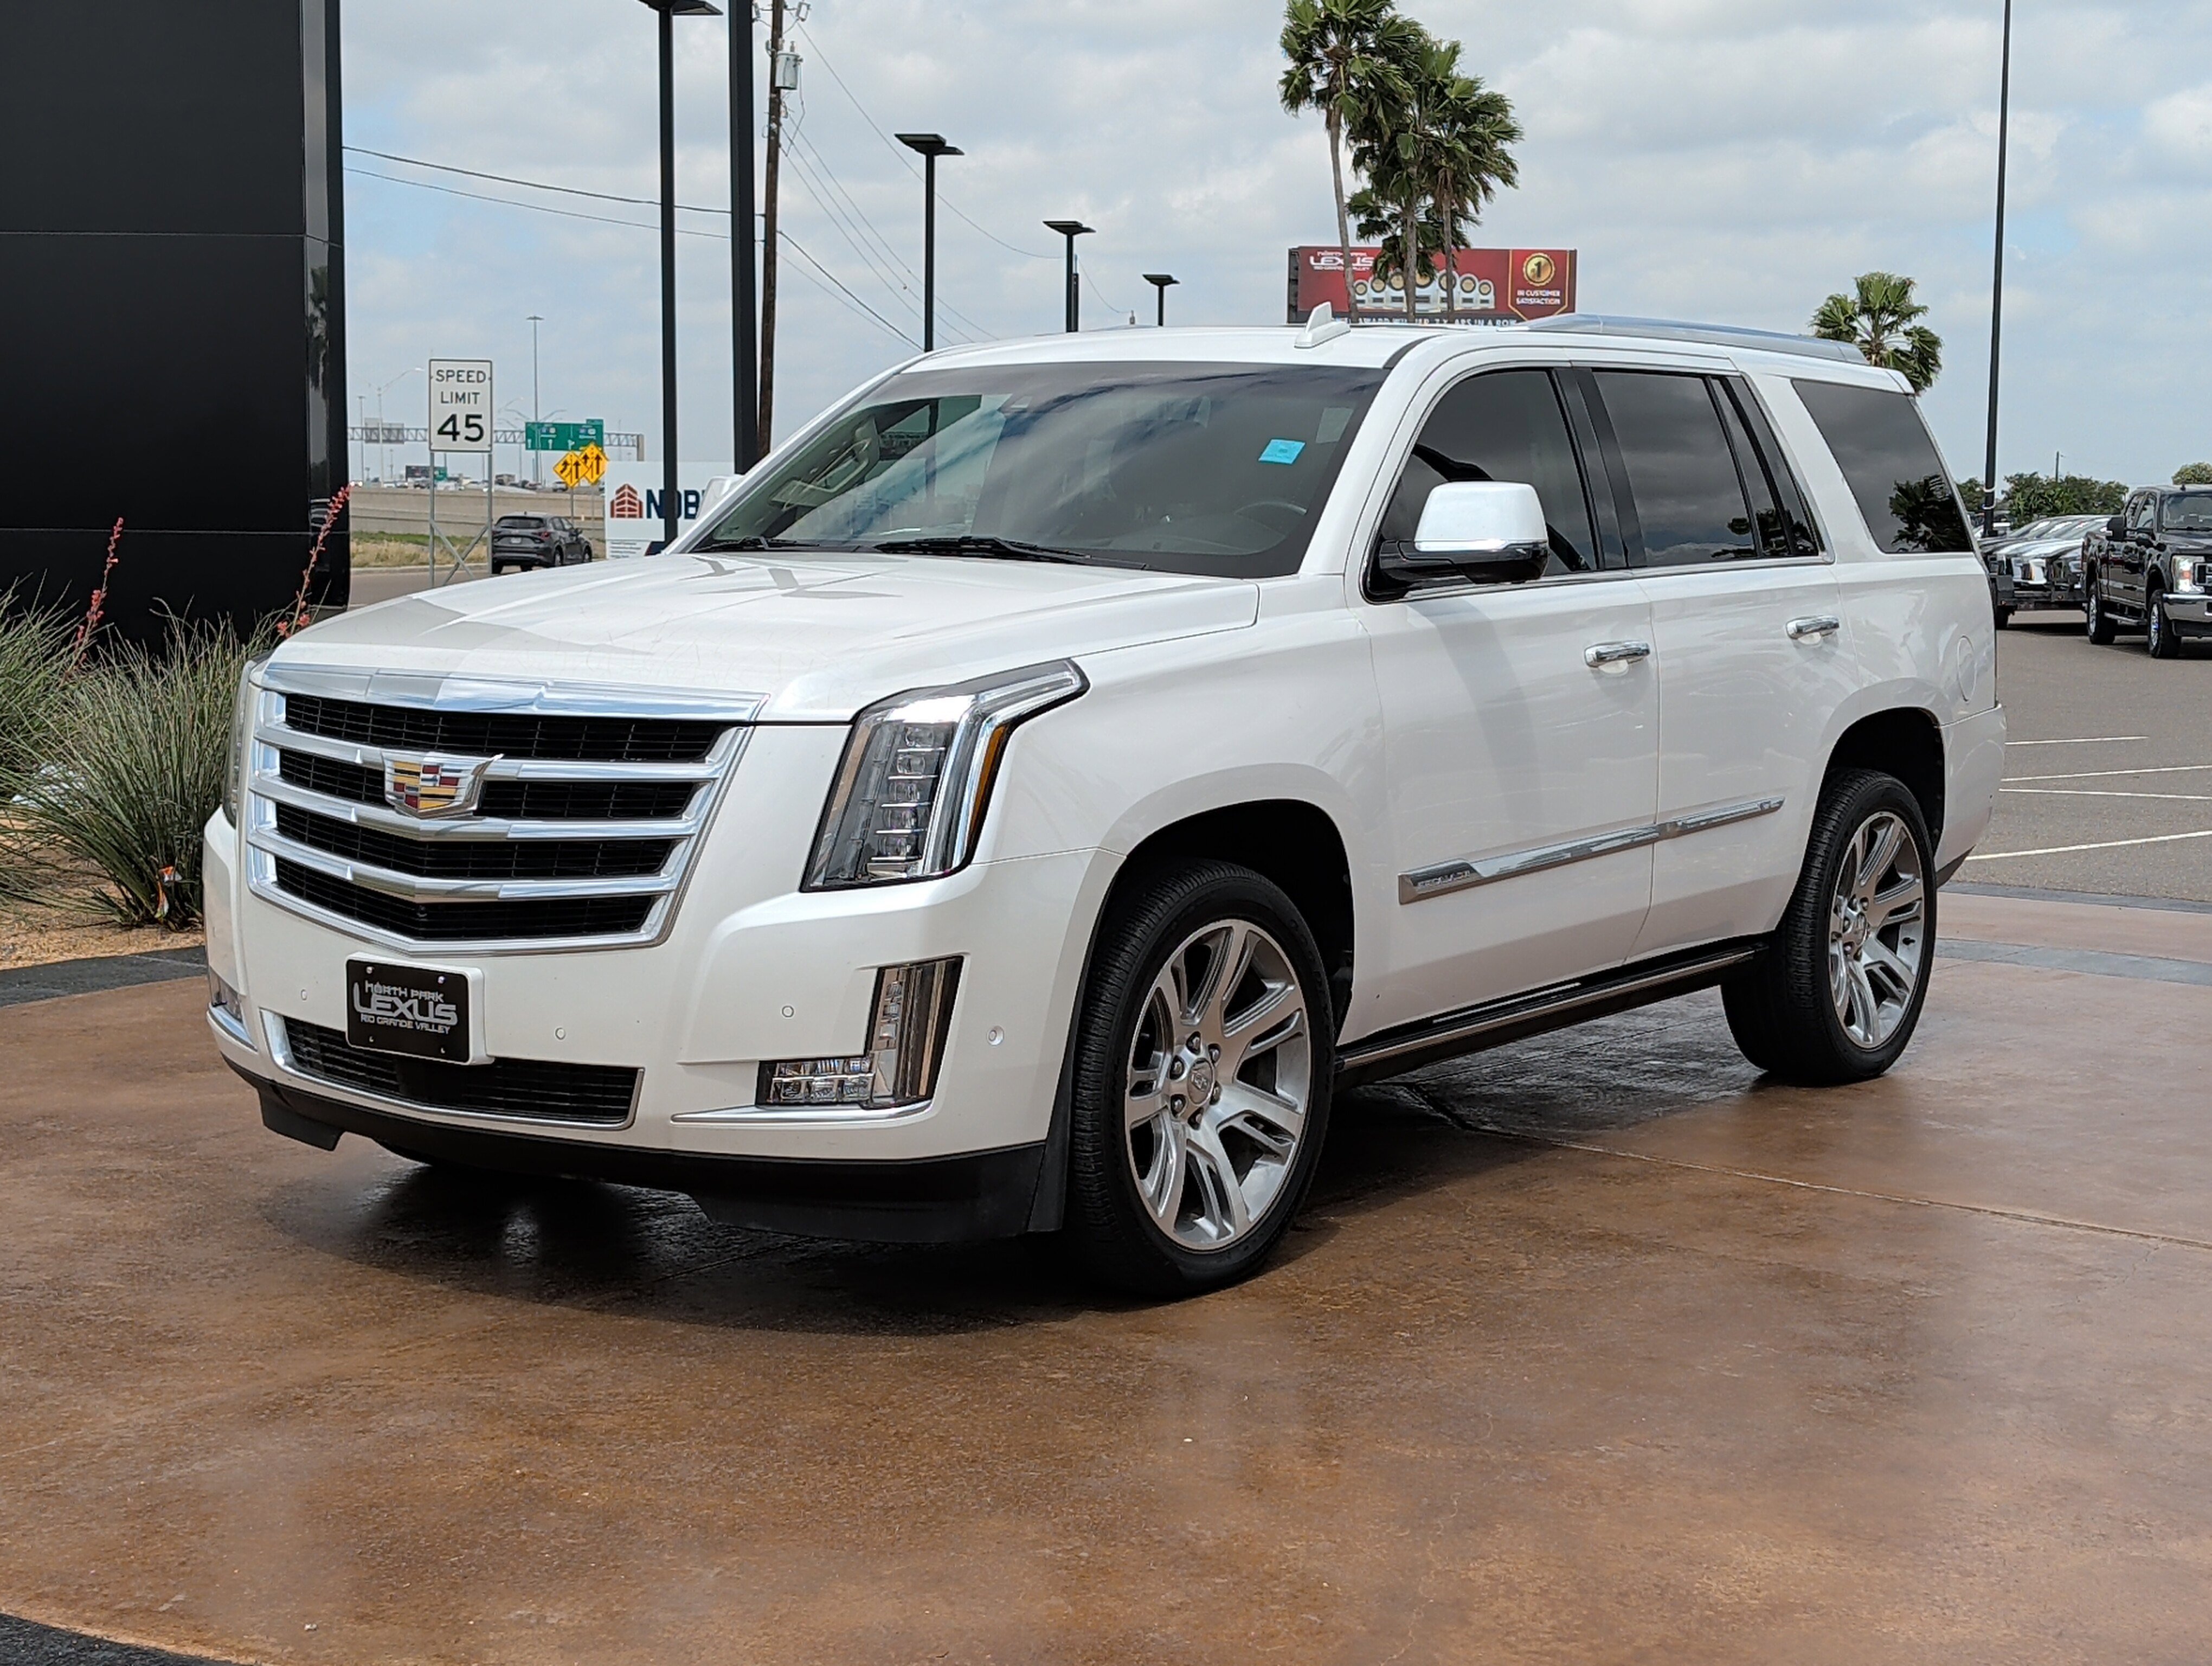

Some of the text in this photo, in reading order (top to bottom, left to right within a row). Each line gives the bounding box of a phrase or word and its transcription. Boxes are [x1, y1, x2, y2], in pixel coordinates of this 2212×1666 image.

[436, 369, 486, 383] SPEED
[440, 391, 480, 405] LIMIT
[436, 413, 485, 443] 45
[365, 979, 444, 1003] NORTH PARK
[353, 982, 458, 1026] LEXUS
[361, 1013, 451, 1034] RIO GRANDE VALLEY
